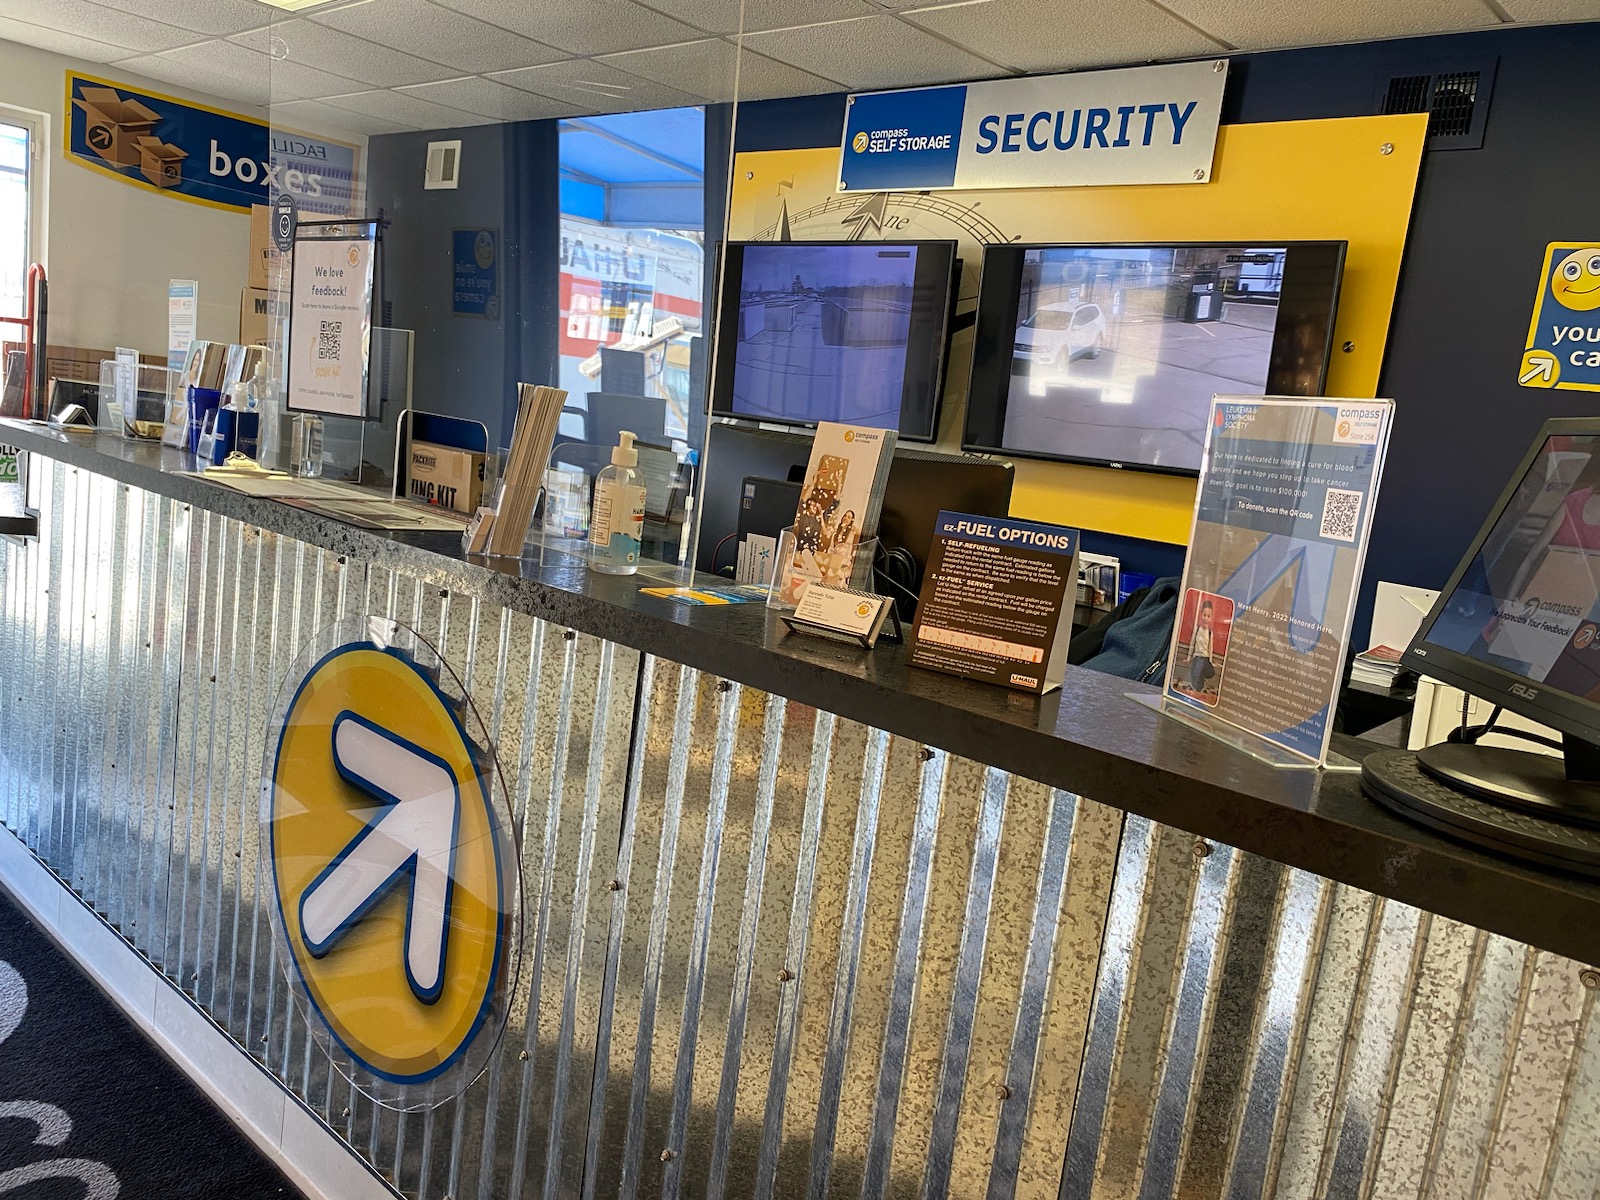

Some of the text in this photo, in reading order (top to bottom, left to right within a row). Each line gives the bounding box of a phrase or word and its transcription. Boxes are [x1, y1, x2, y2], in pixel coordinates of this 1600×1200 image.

[870, 128, 908, 140] compass
[976, 102, 1198, 154] SECURITY
[869, 135, 951, 153] SELF STORAGE
[210, 139, 322, 198] boxes
[315, 266, 344, 277] We love
[312, 285, 347, 296] feedback!
[1340, 408, 1380, 420] compass
[413, 454, 436, 467] PACKRITE
[1244, 455, 1272, 464] dedicated
[1252, 470, 1266, 479] hope
[1279, 474, 1292, 482] step
[438, 484, 456, 508] KIT
[1235, 482, 1248, 491] goal
[1262, 486, 1277, 494] raise
[1278, 488, 1308, 498] $100,000!
[1246, 503, 1265, 512] donate,
[1299, 511, 1314, 520] code
[998, 528, 1070, 549] OPTIONS
[947, 540, 1000, 553] SELF-REFUELING
[966, 580, 994, 589] SERVICE
[1540, 601, 1582, 616] compass
[1237, 603, 1333, 634] Meet Henry, 2022 Honored Hero
[1499, 611, 1528, 625] Appreciate
[1527, 618, 1541, 629] Your
[1540, 621, 1573, 637] Feedback!
[1012, 676, 1036, 684] U-HAUL
[1508, 683, 1538, 700] ASUS
